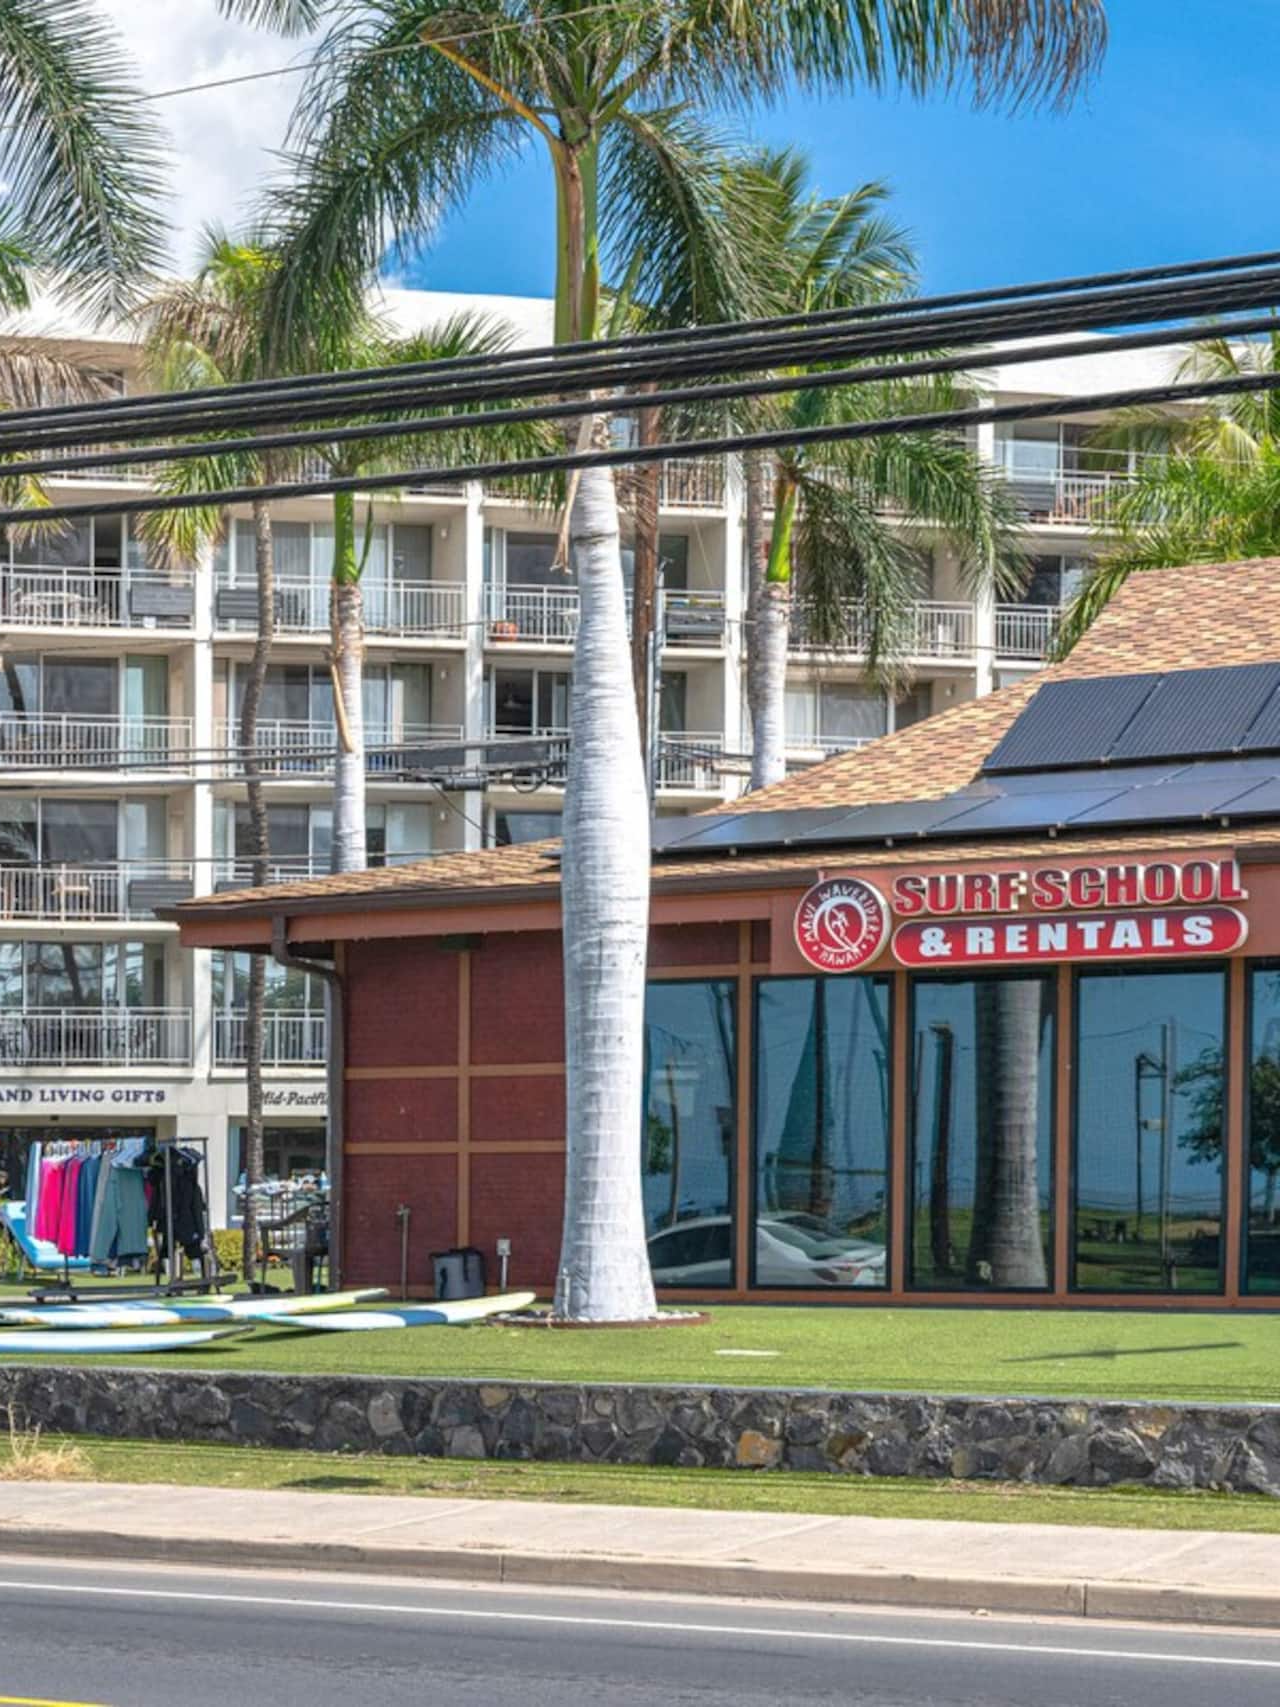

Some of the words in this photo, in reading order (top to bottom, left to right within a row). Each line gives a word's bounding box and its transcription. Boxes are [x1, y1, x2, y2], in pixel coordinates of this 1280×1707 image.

[893, 871, 1026, 916] SURF
[1032, 859, 1248, 910] SCHOOL
[919, 926, 952, 958] &
[965, 915, 1213, 956] RENTALS
[39, 1089, 105, 1102] LIVING
[111, 1089, 166, 1103] GIFTS
